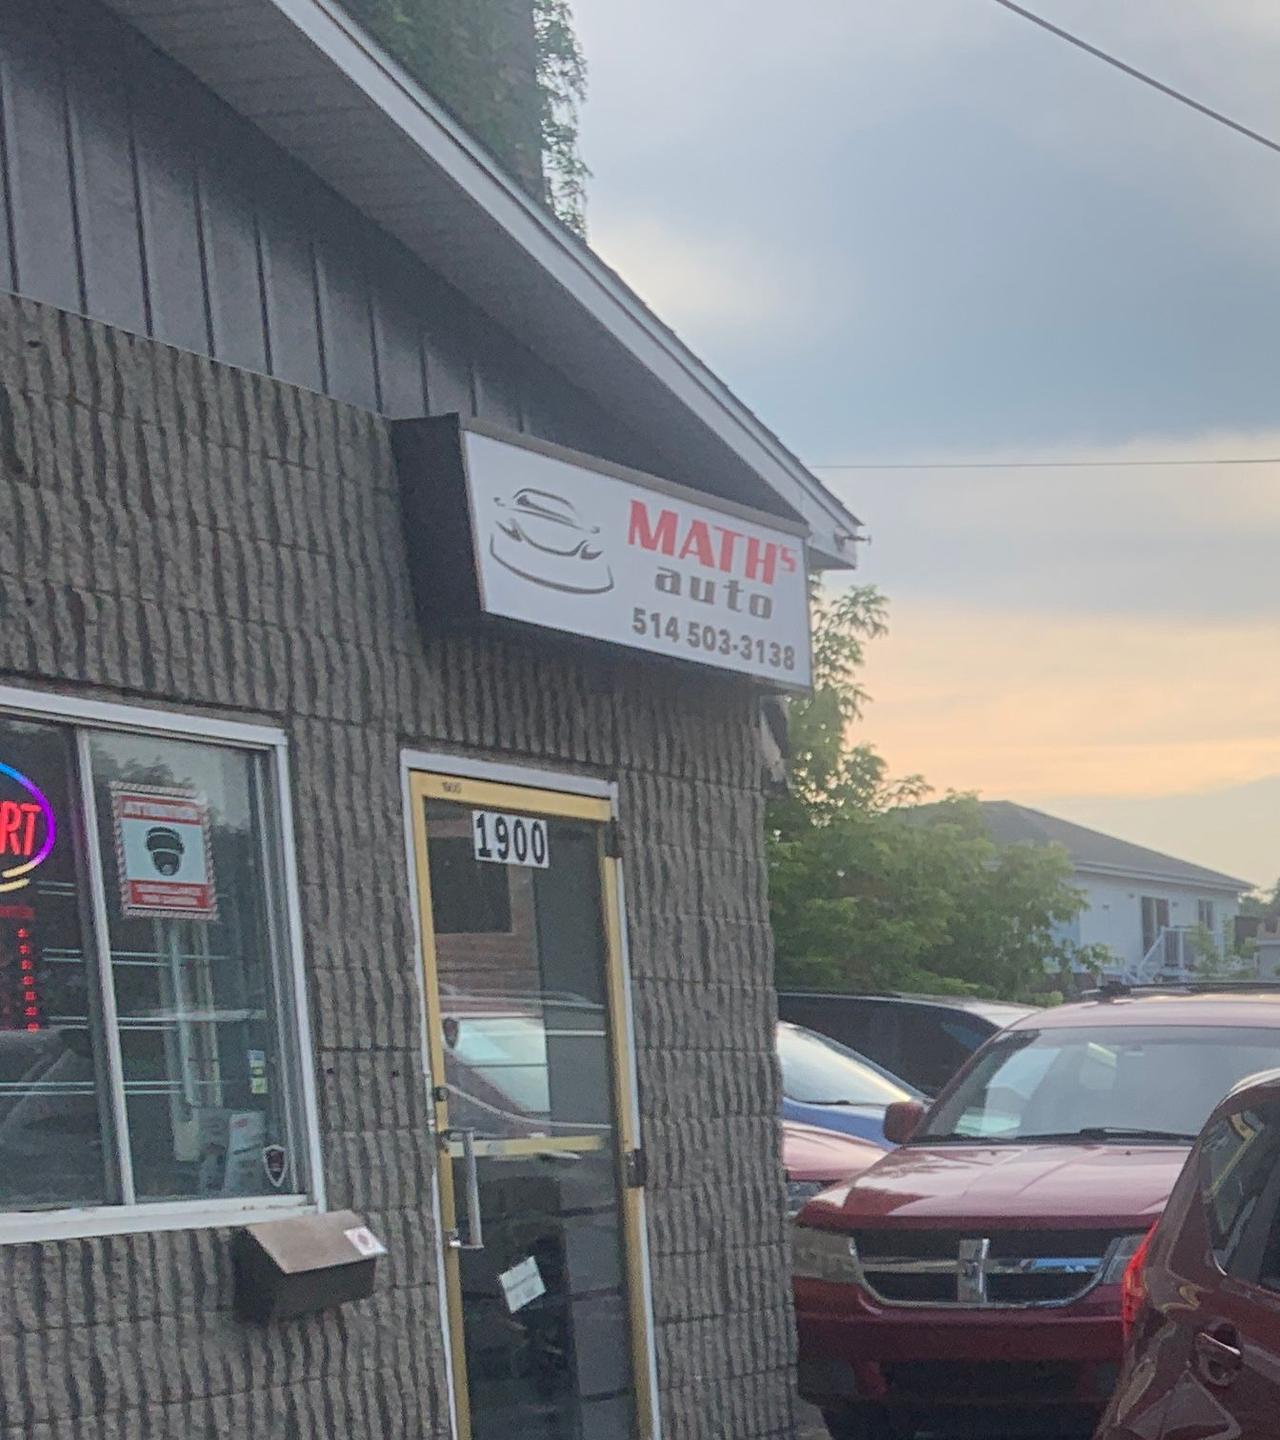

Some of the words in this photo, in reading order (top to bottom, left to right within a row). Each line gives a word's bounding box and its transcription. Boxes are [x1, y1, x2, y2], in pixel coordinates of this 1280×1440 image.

[654, 566, 773, 620] auto
[632, 607, 681, 643] 514
[687, 621, 795, 671] 503-3138
[476, 813, 545, 864] 1900
